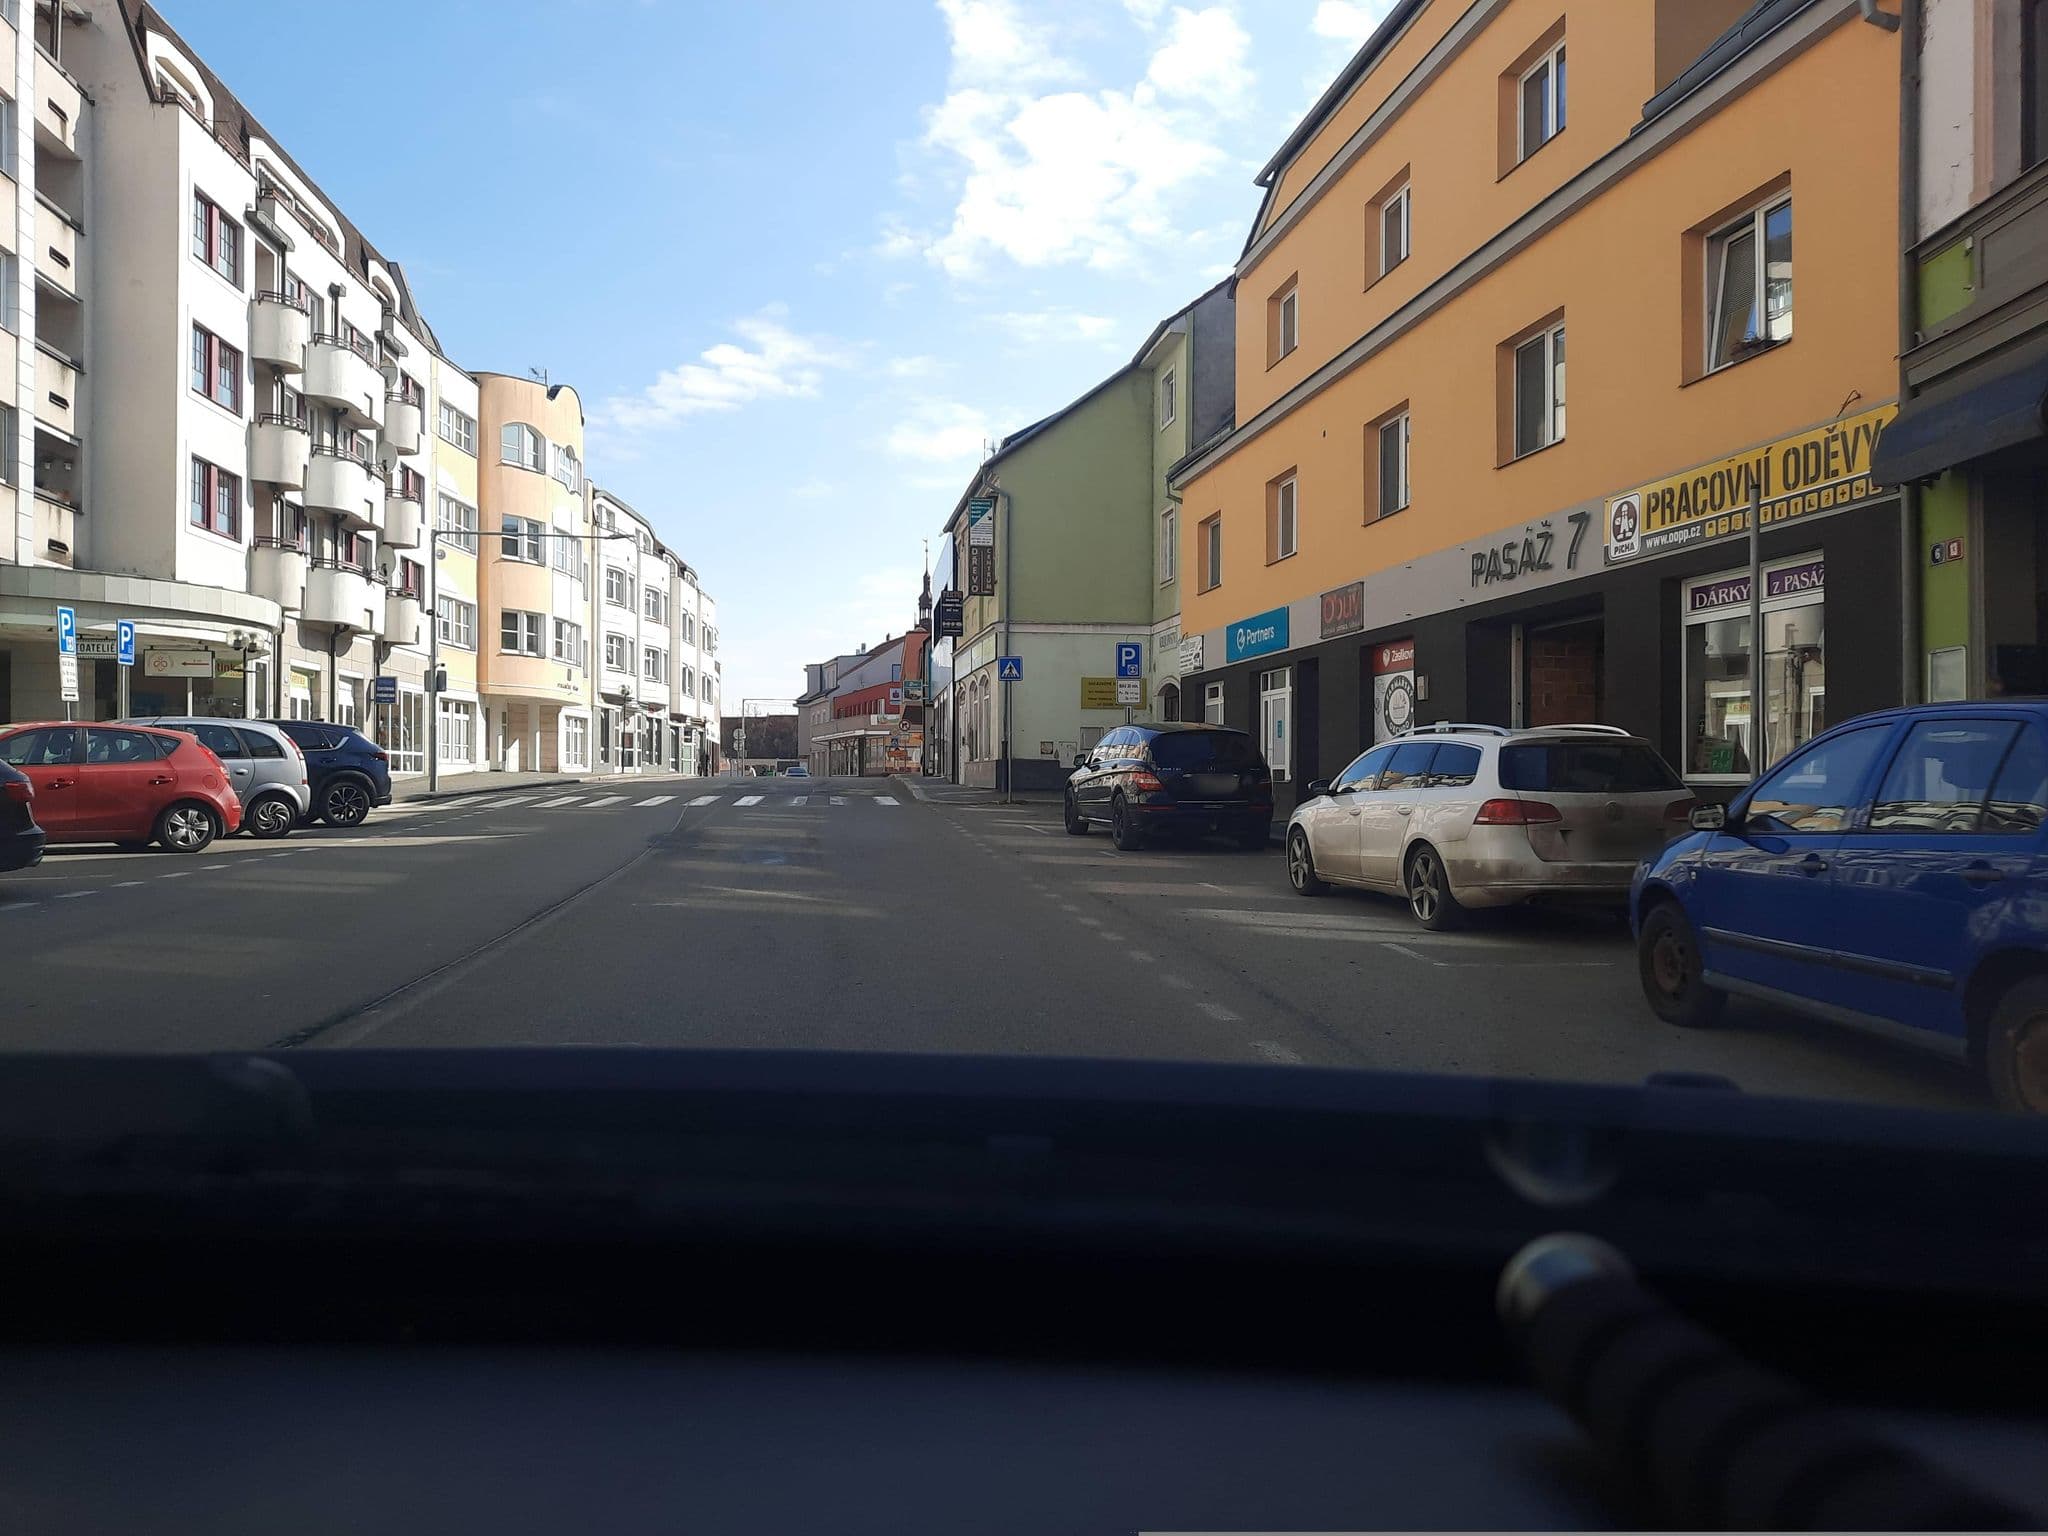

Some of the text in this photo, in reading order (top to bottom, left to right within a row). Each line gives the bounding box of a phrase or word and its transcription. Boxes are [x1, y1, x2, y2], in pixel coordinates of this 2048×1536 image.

[1646, 418, 1884, 530] PRACOVNÍ ODĚVY
[1472, 511, 1591, 587] PASÁŽ 7
[1646, 525, 1701, 549] www.oopp.cz
[1695, 583, 1751, 608] DÁRKY
[61, 612, 71, 640] P
[121, 625, 131, 651] P
[1246, 626, 1275, 645] Partners
[1121, 647, 1136, 667] P
